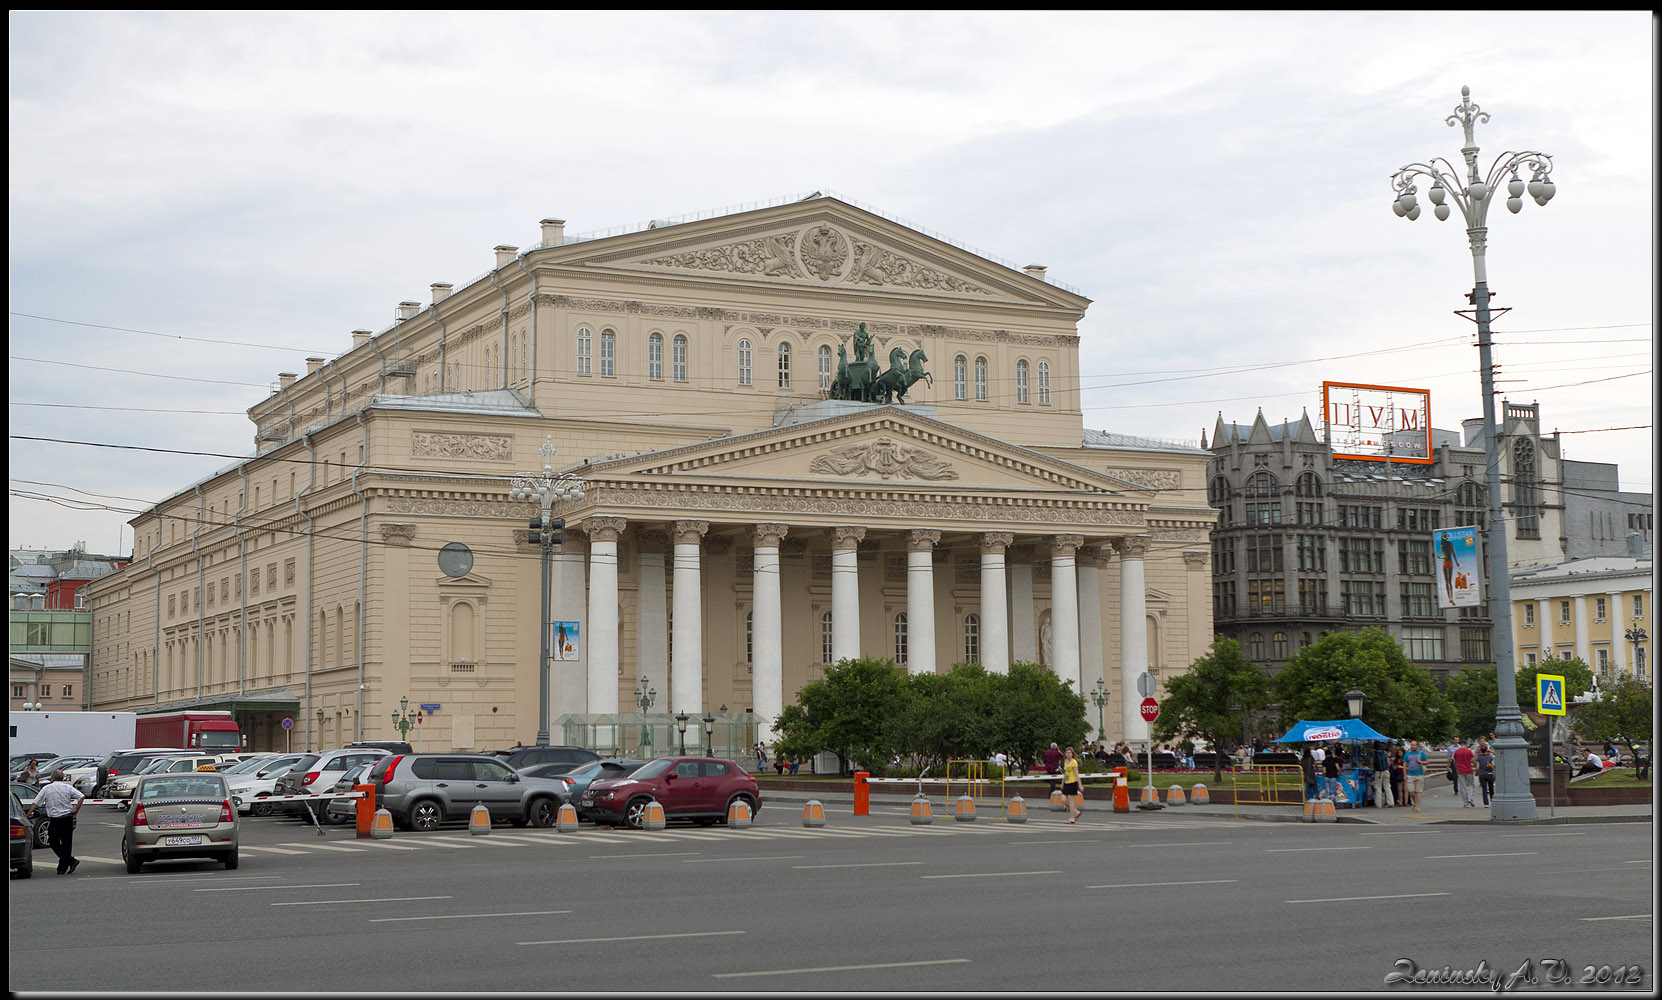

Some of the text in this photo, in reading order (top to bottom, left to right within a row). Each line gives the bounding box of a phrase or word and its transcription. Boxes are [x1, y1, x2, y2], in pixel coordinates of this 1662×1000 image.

[1331, 403, 1419, 431] ЦУМ
[1372, 440, 1421, 449] MOSCOW
[1141, 705, 1158, 714] STOP
